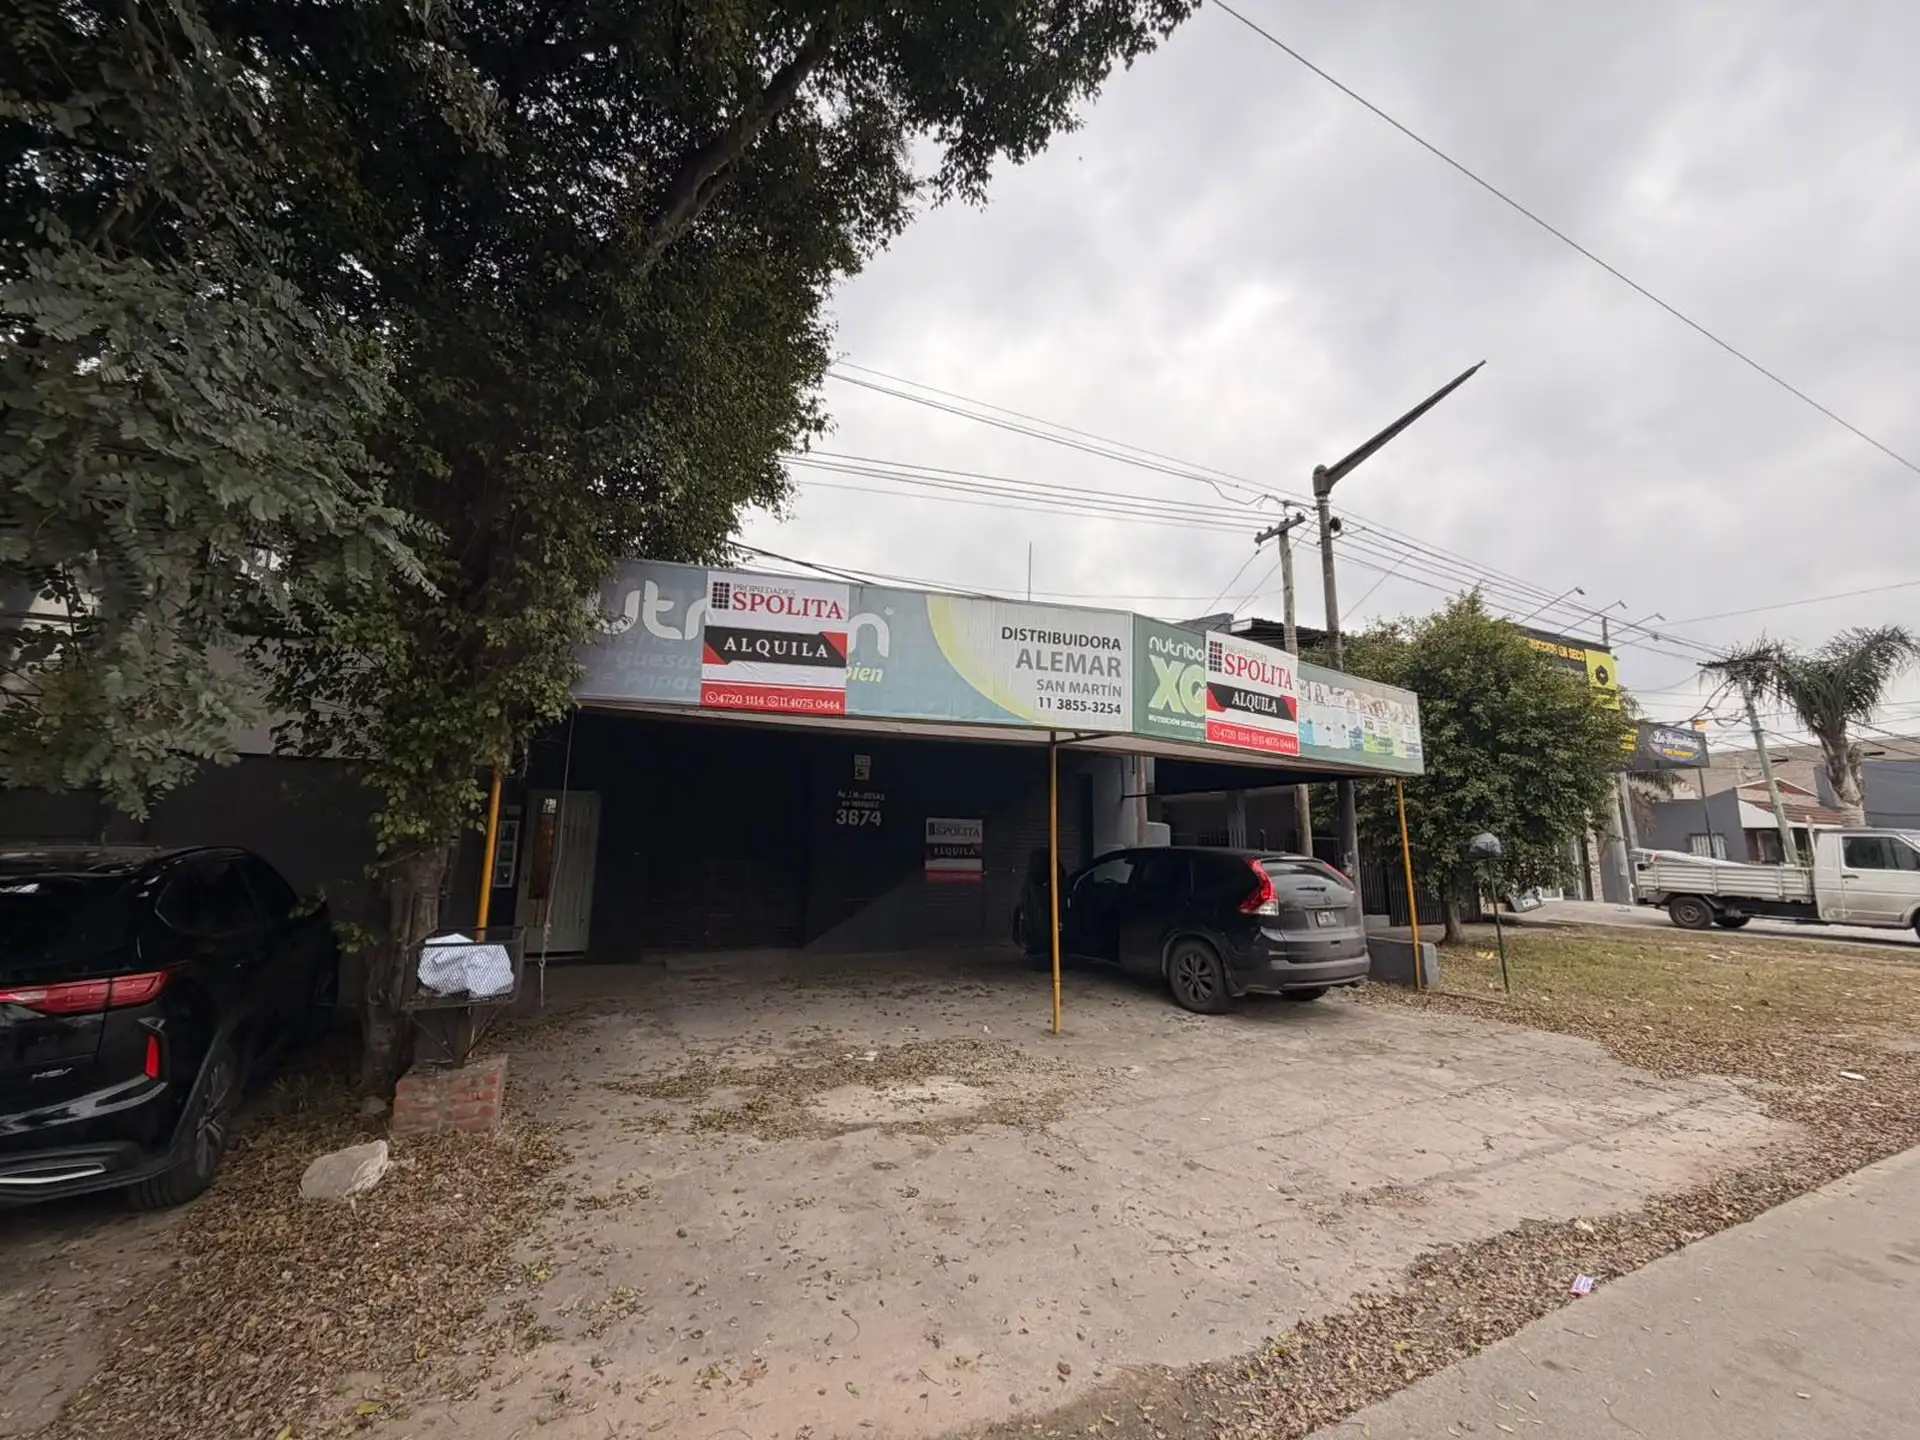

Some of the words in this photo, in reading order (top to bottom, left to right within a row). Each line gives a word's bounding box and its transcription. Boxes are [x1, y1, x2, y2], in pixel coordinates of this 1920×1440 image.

[733, 583, 797, 596] PROPIEDADES
[732, 591, 844, 620] SPOLITA
[723, 636, 829, 658] ALQUILA
[1001, 626, 1122, 651] DISTRIBUIDORA
[1148, 636, 1206, 662] nutribo
[1015, 648, 1122, 678] ALEMAR
[1224, 653, 1293, 690] SPOLITA
[1036, 679, 1065, 694] SAN
[1069, 677, 1122, 697] MARTÍN
[718, 692, 743, 705] 4720
[1037, 696, 1052, 709] 11
[1057, 698, 1122, 715] 3855-3254
[1231, 691, 1277, 713] ALQUILA
